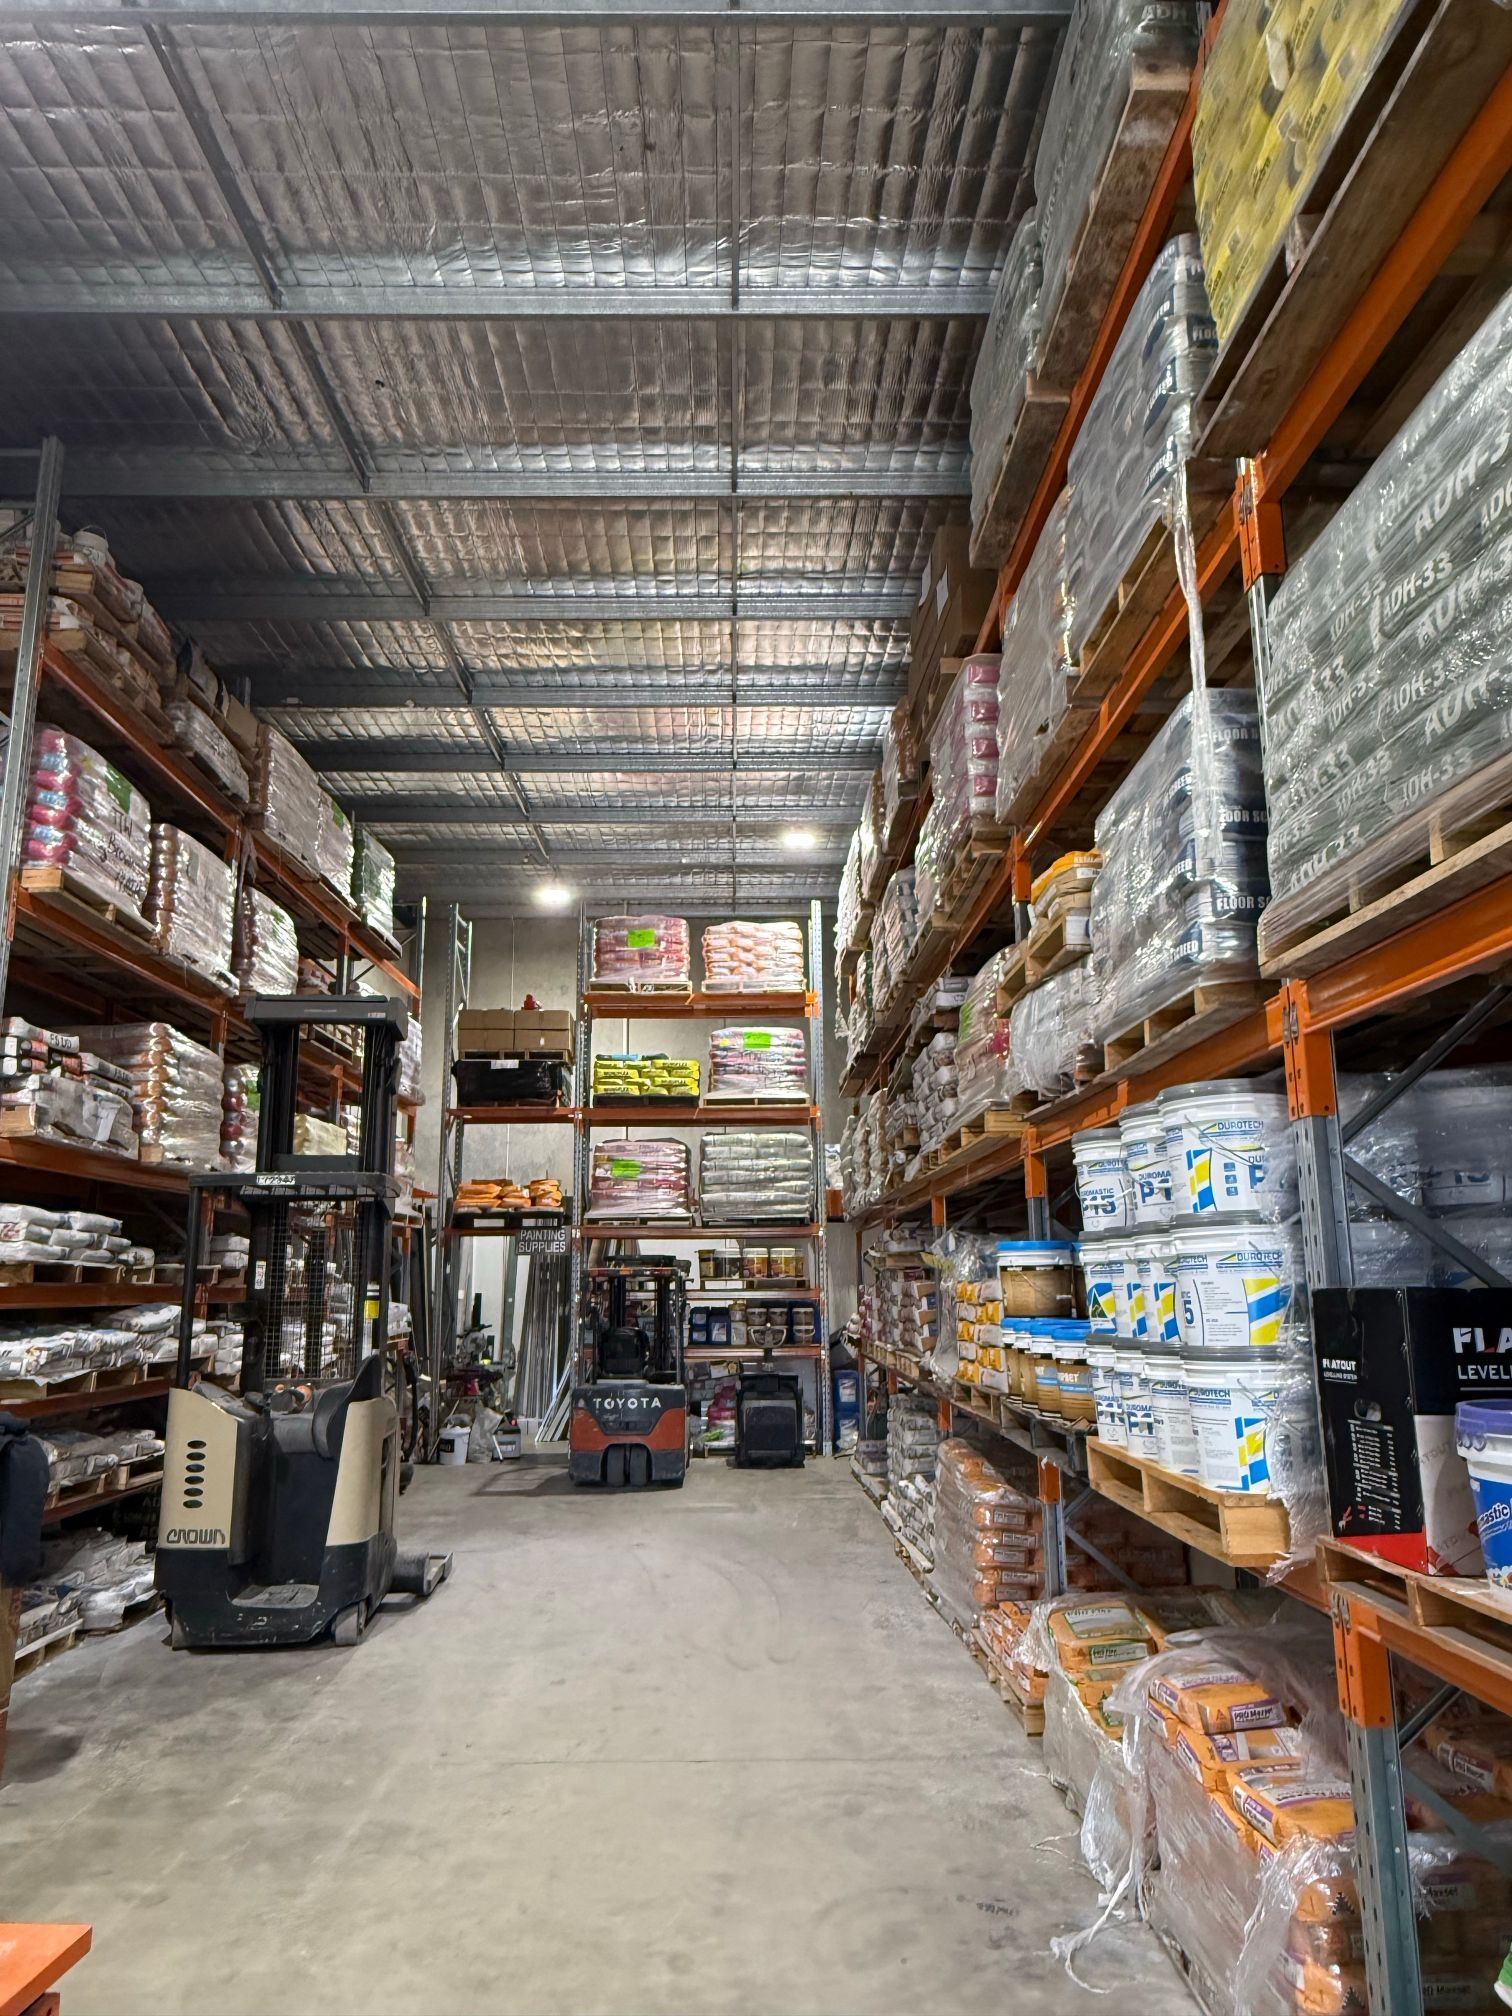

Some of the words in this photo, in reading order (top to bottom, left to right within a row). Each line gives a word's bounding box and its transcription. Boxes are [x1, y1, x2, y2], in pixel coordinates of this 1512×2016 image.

[1216, 896, 1255, 911] FLOOR
[1217, 1120, 1264, 1131] DUROTECH
[520, 1229, 566, 1240] PAINTING
[518, 1241, 566, 1253] SUPPLIES
[1452, 1327, 1512, 1354] FLA
[593, 1397, 662, 1409] TOYOTA
